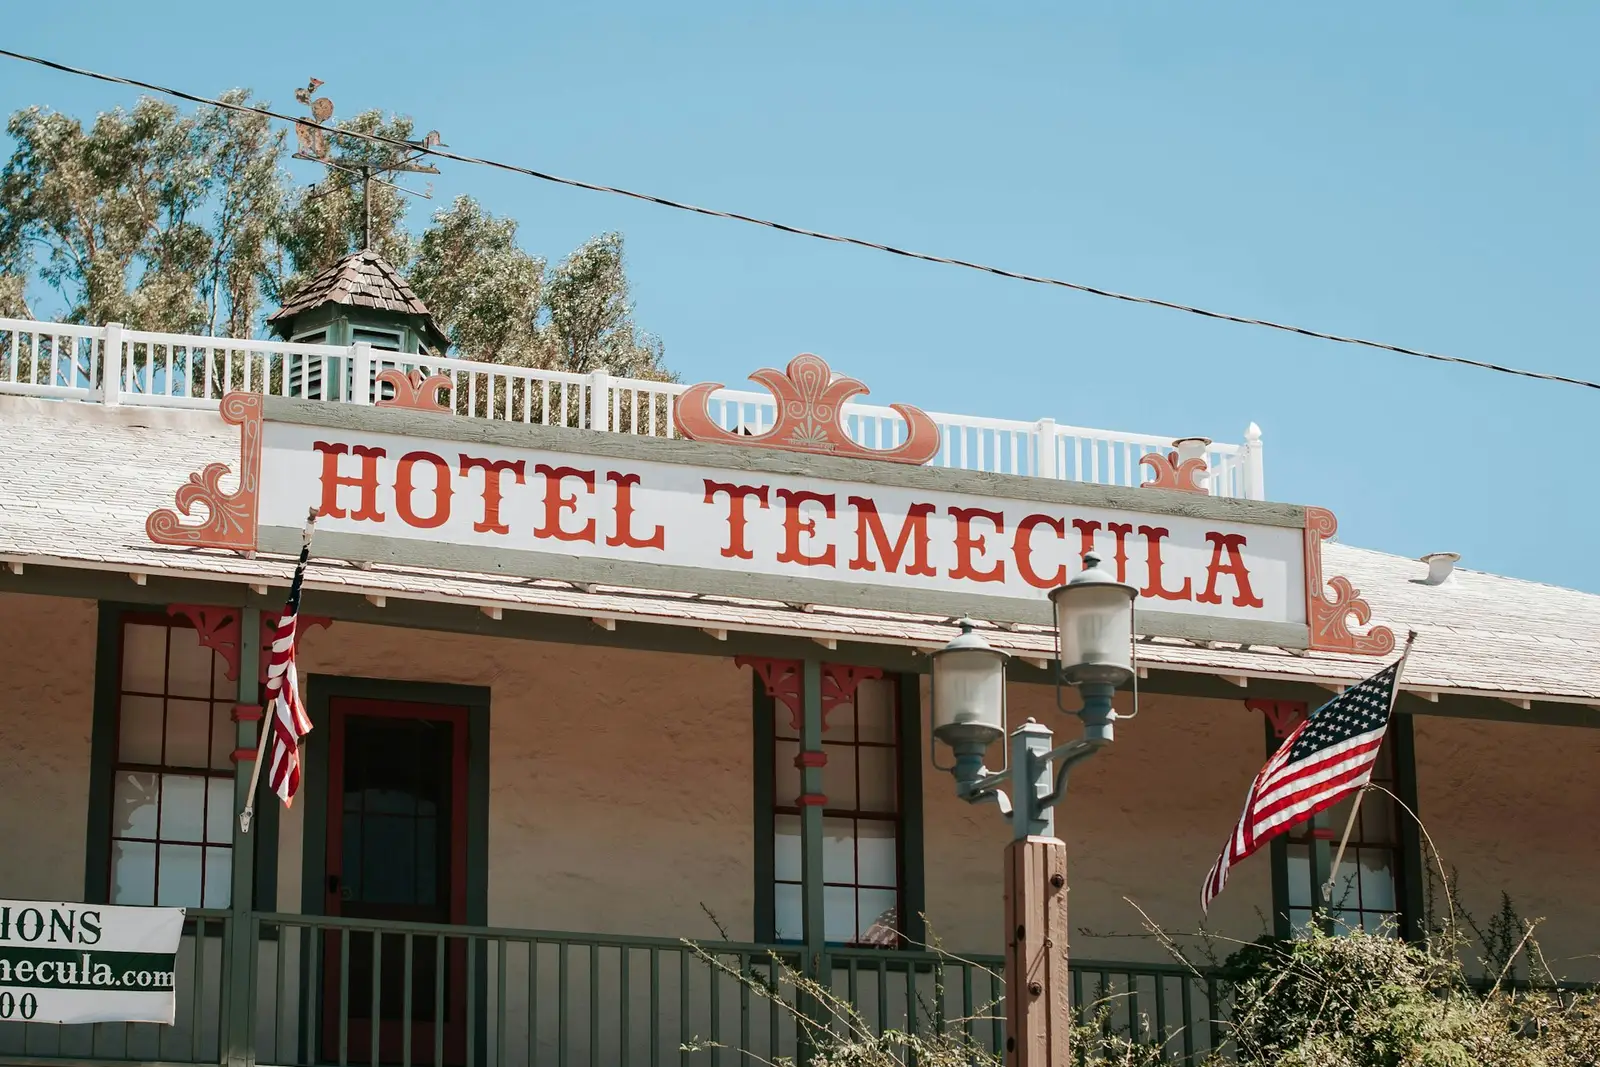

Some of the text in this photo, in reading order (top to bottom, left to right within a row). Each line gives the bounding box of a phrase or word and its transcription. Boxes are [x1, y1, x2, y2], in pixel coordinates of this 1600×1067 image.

[313, 441, 1264, 609] HOTEL TEMECULA
[0, 906, 102, 944] IONS
[0, 991, 38, 1020] 00
